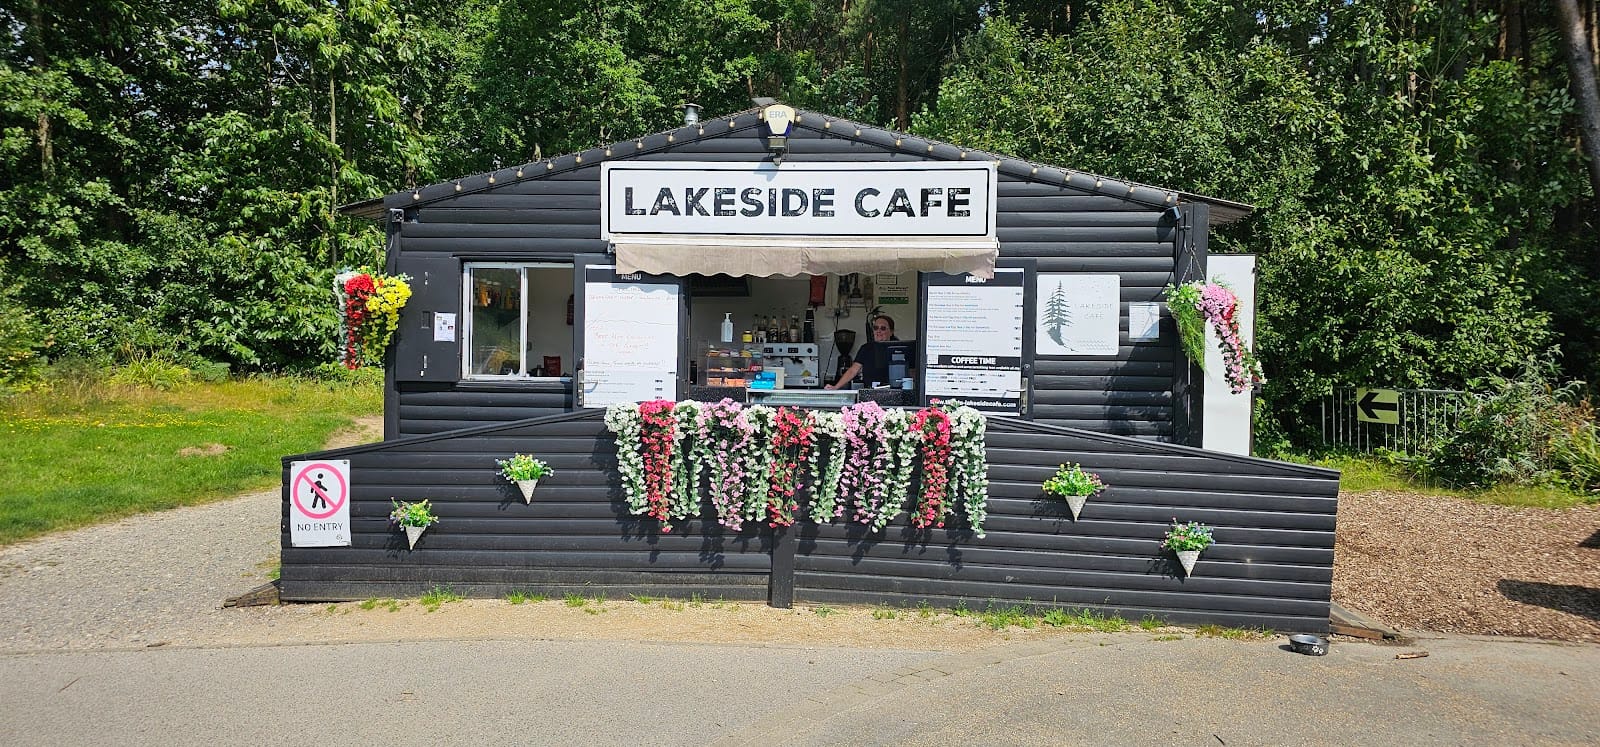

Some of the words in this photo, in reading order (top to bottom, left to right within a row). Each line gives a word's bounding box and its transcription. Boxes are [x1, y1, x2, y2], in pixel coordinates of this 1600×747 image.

[769, 110, 787, 119] ERA
[623, 186, 836, 218] LAKESIDE
[854, 187, 971, 218] CAFE
[951, 356, 979, 364] COFFEE
[979, 357, 997, 365] TIME
[313, 522, 343, 531] ENTRY
